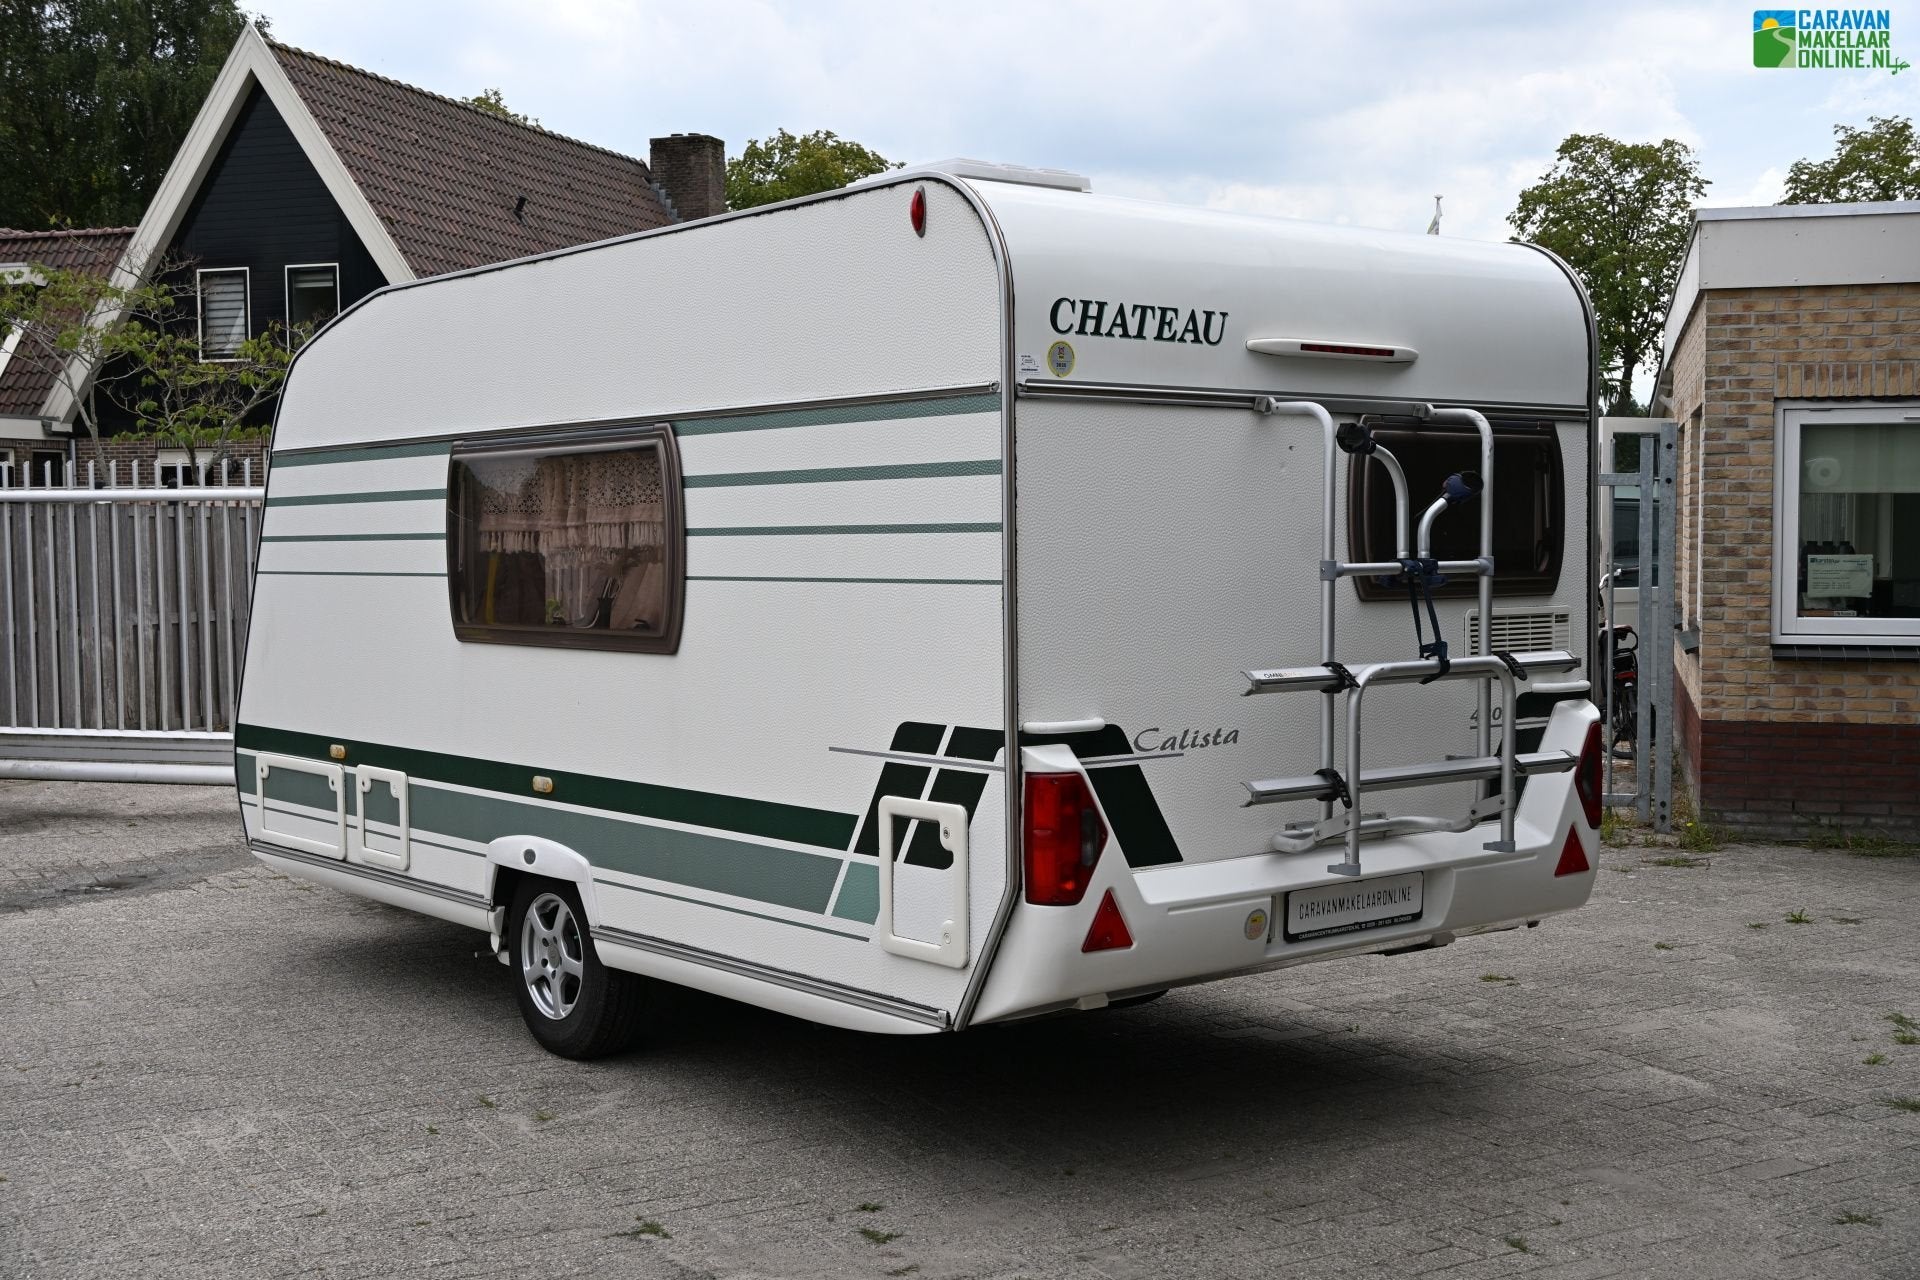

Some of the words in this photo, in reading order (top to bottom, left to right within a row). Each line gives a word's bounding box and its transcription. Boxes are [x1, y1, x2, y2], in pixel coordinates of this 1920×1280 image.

[1049, 297, 1229, 346] CHATEAU
[1470, 706, 1503, 722] 40
[1133, 727, 1240, 752] Calista
[1299, 886, 1412, 920] CARAVANMAKELAARONLINE
